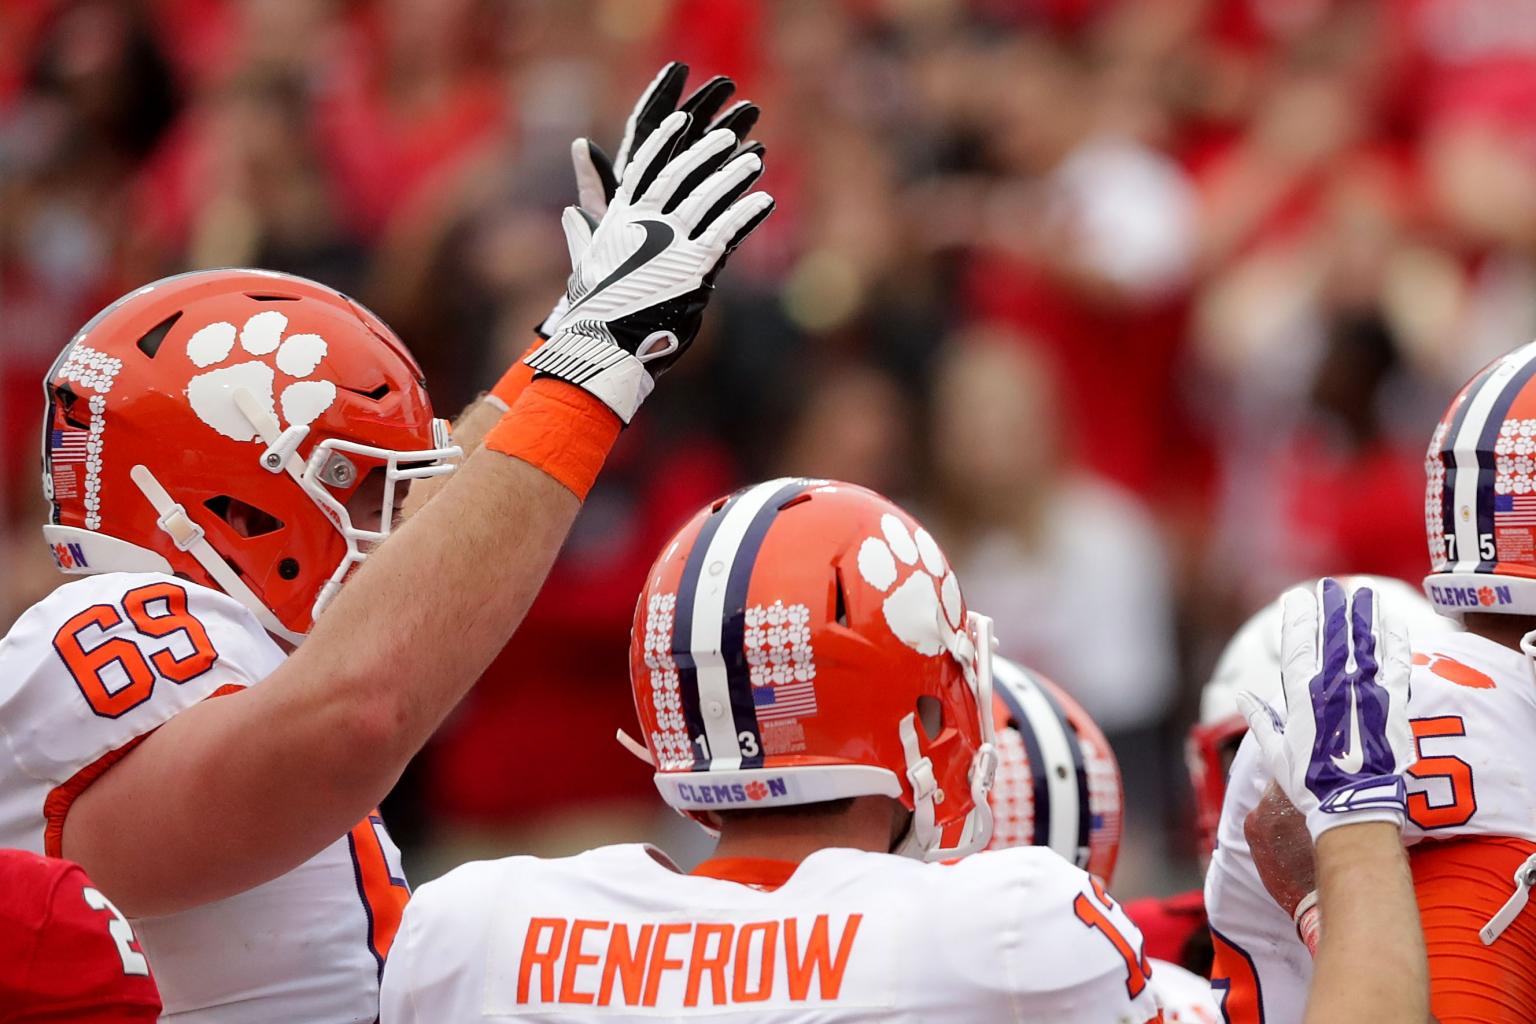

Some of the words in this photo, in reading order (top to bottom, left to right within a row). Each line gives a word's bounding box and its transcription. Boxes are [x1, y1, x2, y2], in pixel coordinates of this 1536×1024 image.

[1444, 534, 1456, 560] 7
[1480, 534, 1496, 560] 5
[54, 581, 219, 718] 69
[695, 734, 710, 760] 1
[738, 731, 760, 758] 3
[517, 912, 864, 1009] RENFROW
